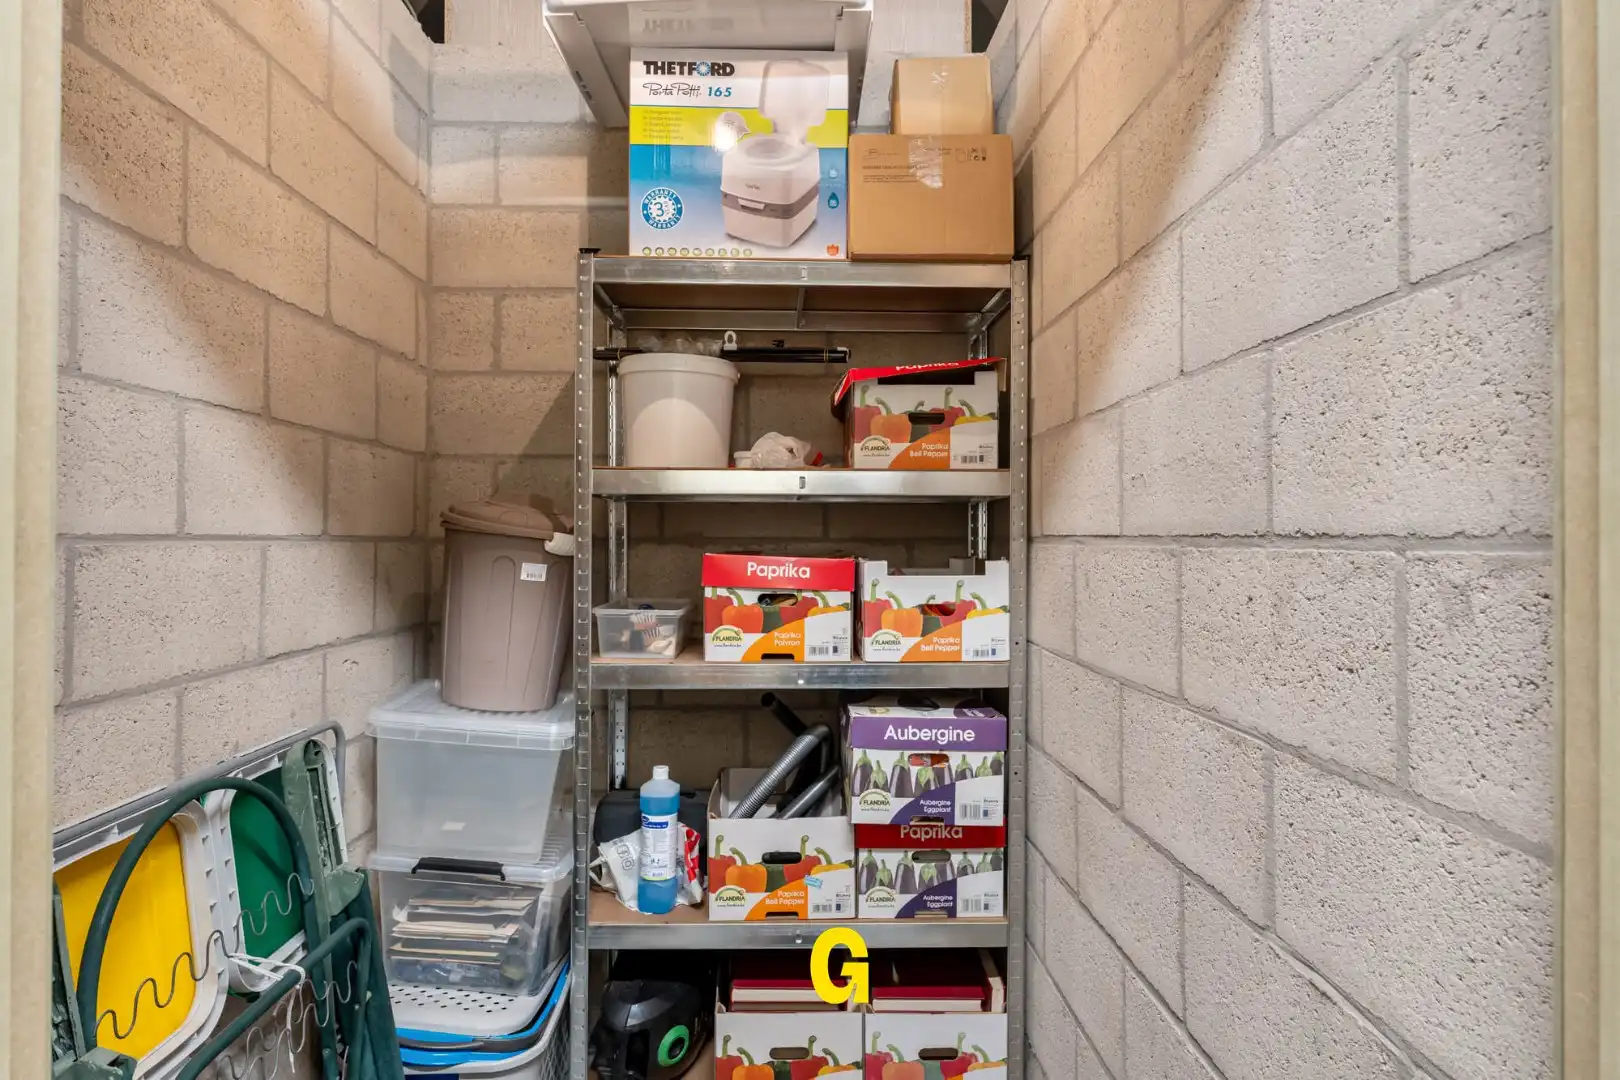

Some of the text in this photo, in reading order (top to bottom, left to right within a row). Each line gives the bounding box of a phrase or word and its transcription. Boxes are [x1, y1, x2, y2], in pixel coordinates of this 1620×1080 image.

[643, 60, 736, 77] THETFORD
[642, 82, 673, 96] Porta
[707, 86, 732, 97] 165
[653, 201, 665, 217] 3
[921, 442, 949, 451] Paprika
[747, 561, 811, 581] Paprika
[774, 632, 801, 640] Paprika
[932, 637, 960, 645] Paprika
[920, 644, 934, 652] Bell
[884, 724, 976, 745] Aubergine
[919, 799, 952, 807] Aubergine
[923, 806, 952, 814] Eggplant
[900, 825, 963, 842] Paprika
[922, 895, 954, 903] Aubergine
[926, 901, 954, 909] Eggplant
